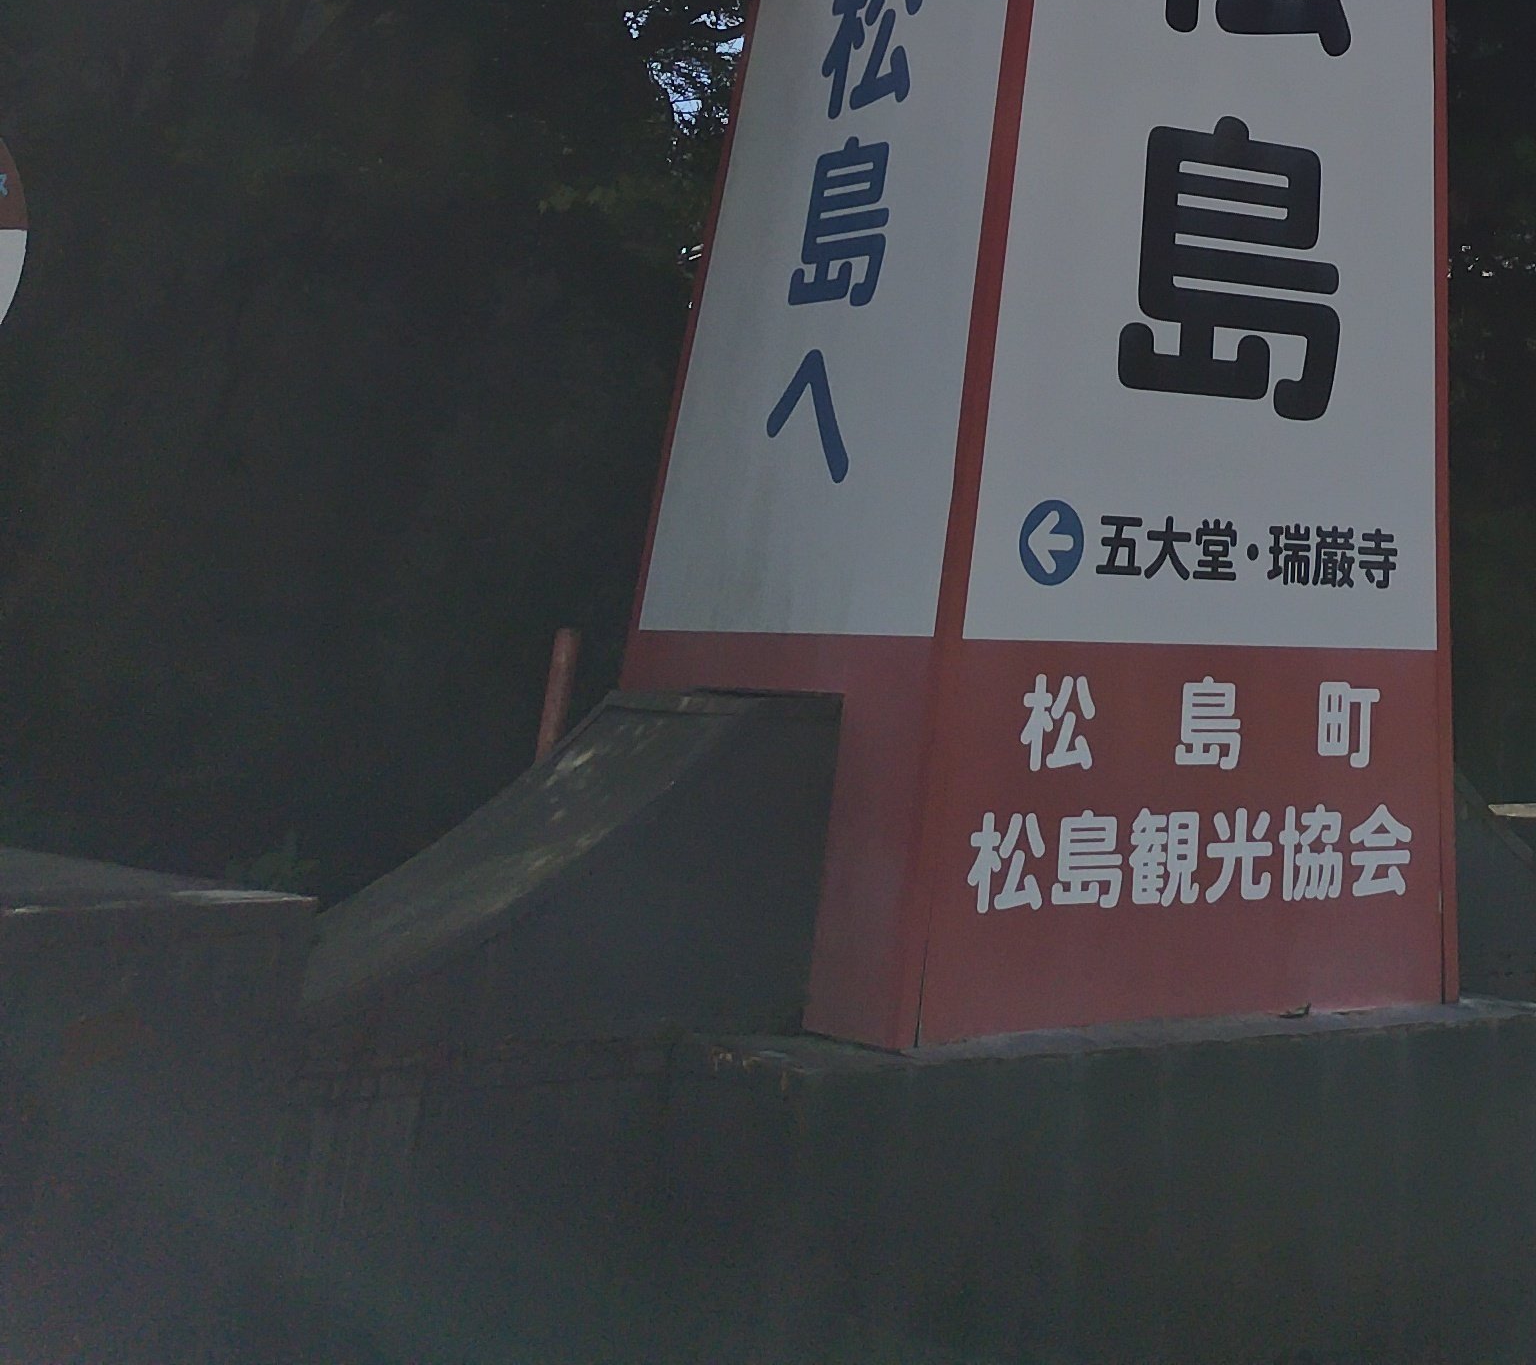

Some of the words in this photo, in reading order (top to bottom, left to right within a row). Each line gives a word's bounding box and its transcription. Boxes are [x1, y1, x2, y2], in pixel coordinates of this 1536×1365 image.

[1019, 674, 1381, 771] 松島町
[967, 804, 1413, 915] 松島観光協会
